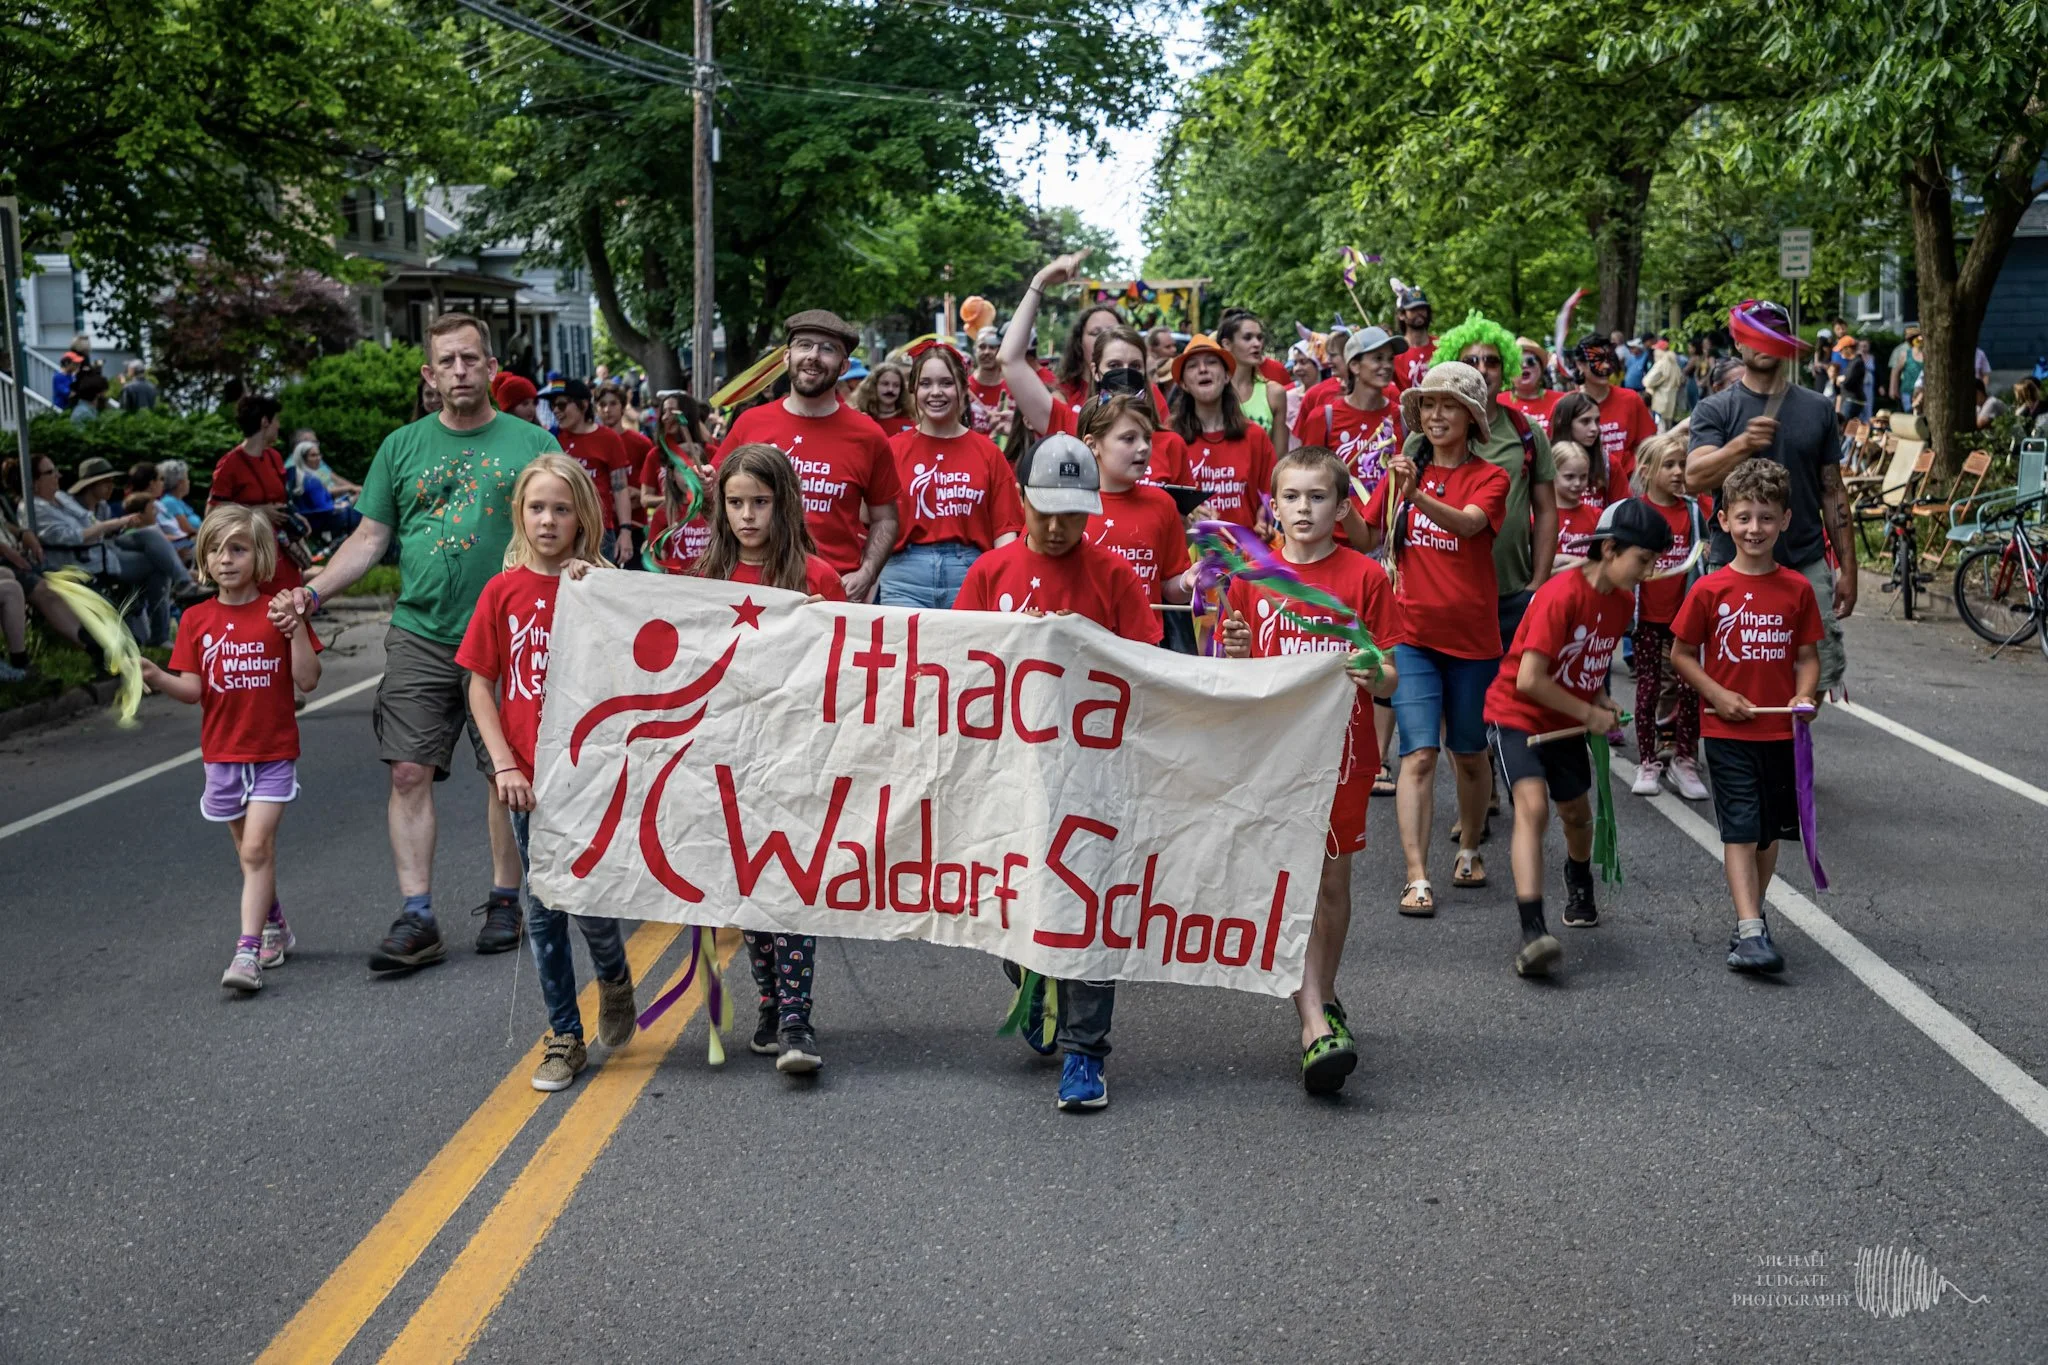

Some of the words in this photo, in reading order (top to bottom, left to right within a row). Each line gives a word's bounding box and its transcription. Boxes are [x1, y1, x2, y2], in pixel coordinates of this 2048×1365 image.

[788, 455, 831, 475] thaca
[1201, 465, 1235, 481] Ithaca
[1357, 466, 1381, 480] Sch
[801, 476, 848, 500] aldorf
[935, 484, 985, 504] Waldorf
[801, 494, 832, 513] hool
[935, 501, 972, 517] School
[1411, 529, 1459, 552] School
[1107, 544, 1153, 560] thaca
[1740, 611, 1783, 628] Ithaca
[529, 626, 550, 650] Ith
[1740, 628, 1794, 645] Waldorf
[221, 640, 265, 657] Ithaca
[1741, 645, 1786, 662] School
[222, 656, 281, 673] Waldorf
[223, 673, 271, 690] School
[822, 612, 1130, 750] Ithaca
[715, 764, 1029, 930] Waldorf
[1033, 814, 1290, 971] School
